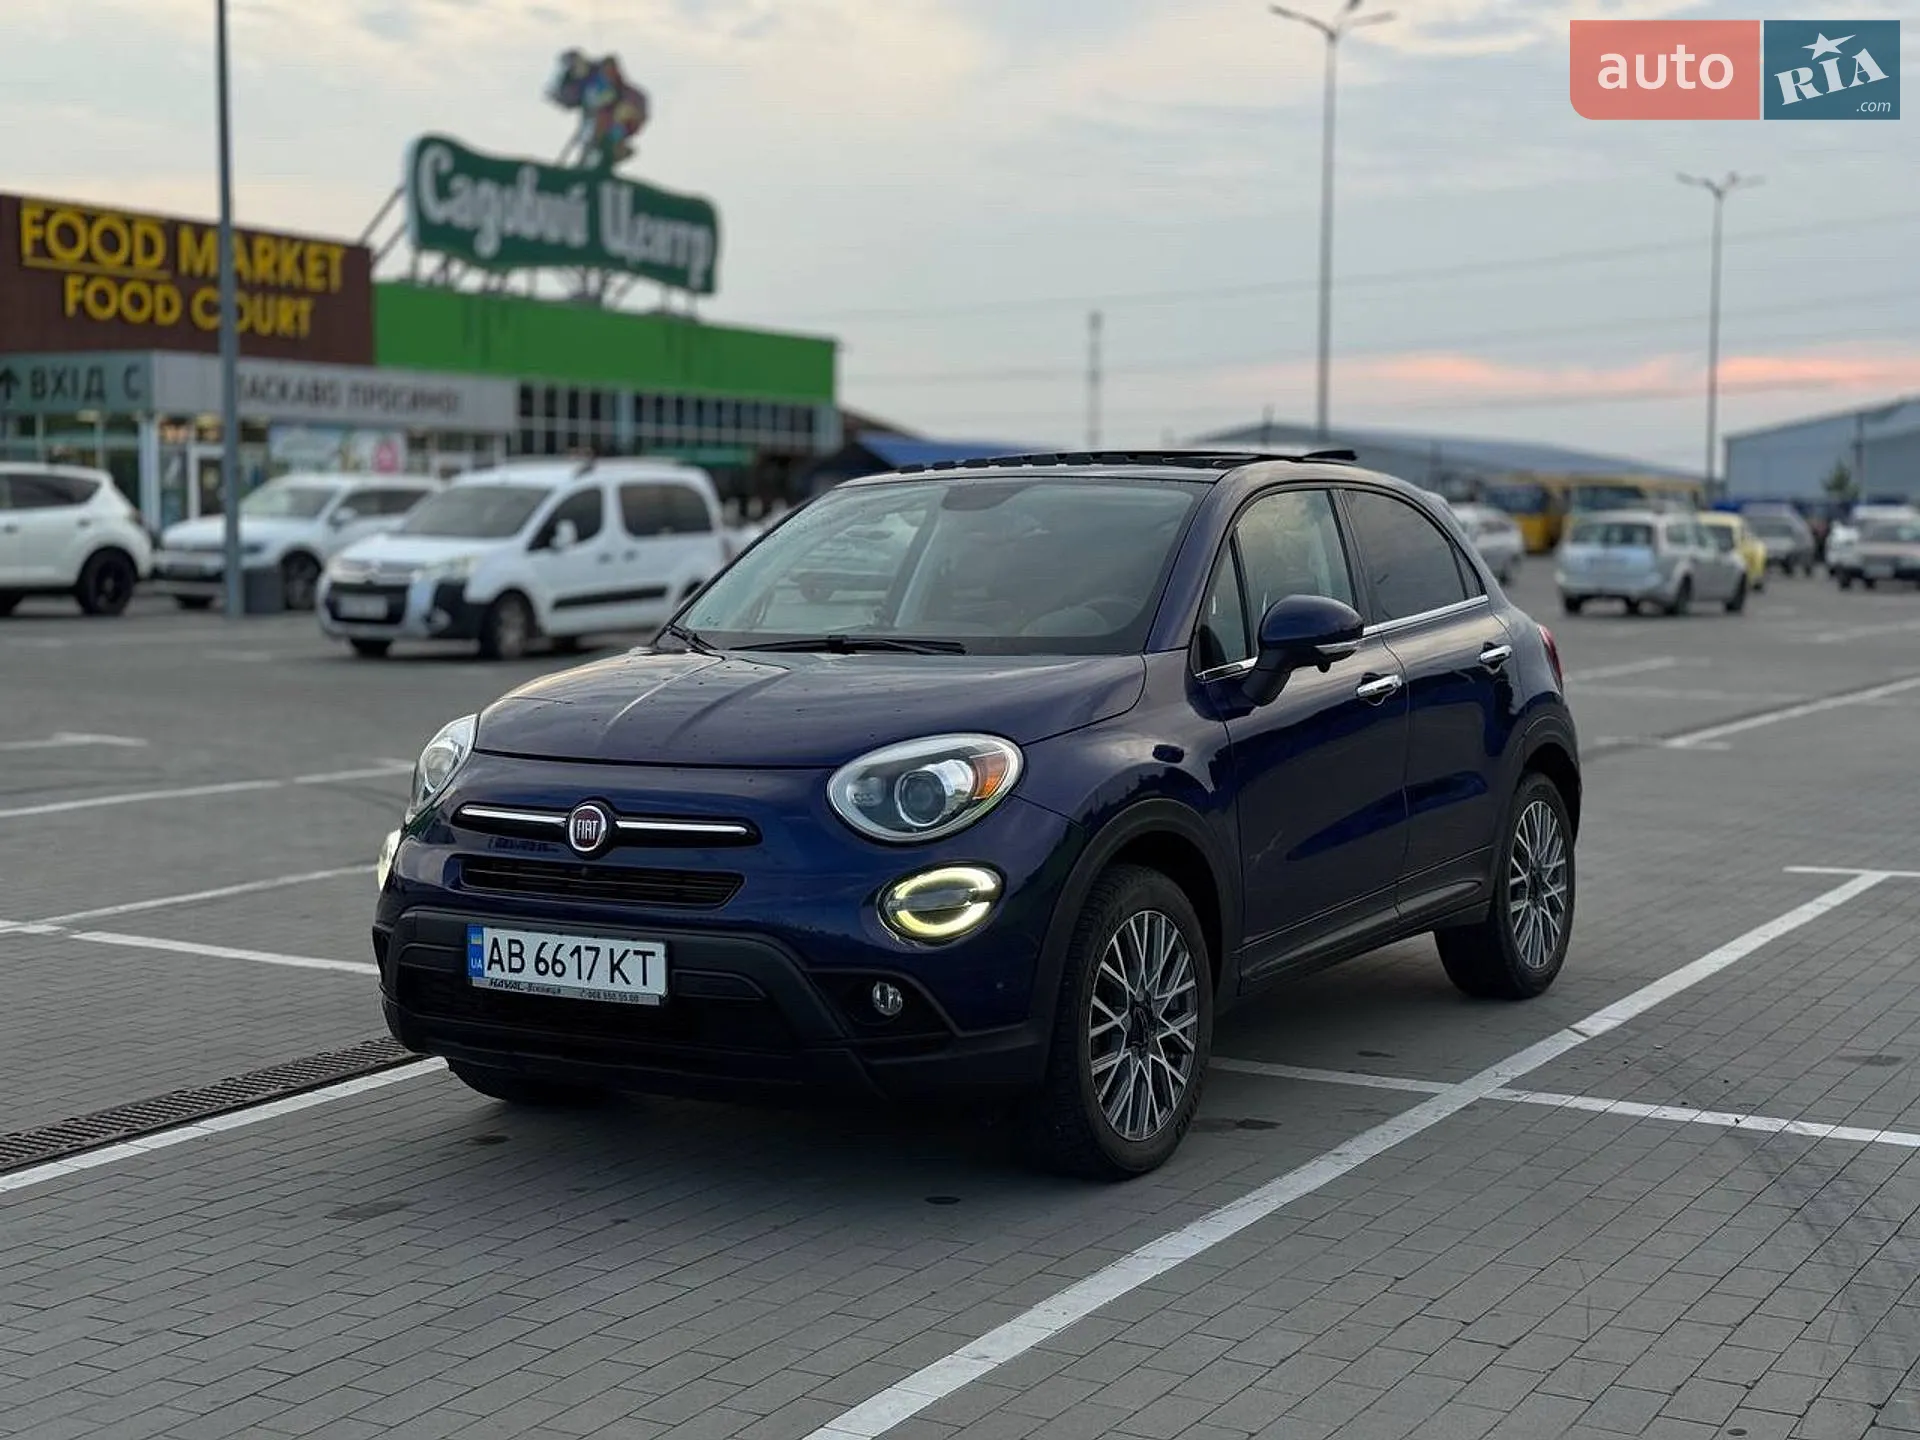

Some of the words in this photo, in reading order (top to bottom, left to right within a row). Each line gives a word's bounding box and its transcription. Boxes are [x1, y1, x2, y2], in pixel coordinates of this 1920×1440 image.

[20, 205, 167, 269] FOOD
[177, 223, 345, 293] MARKET
[64, 273, 182, 327] FOOD
[190, 286, 314, 338] COURT
[29, 363, 106, 406] ВХІД
[576, 819, 599, 840] FIAT
[470, 957, 483, 969] UA
[487, 937, 525, 974] AB
[534, 941, 601, 981] 6617
[609, 948, 656, 986] KT
